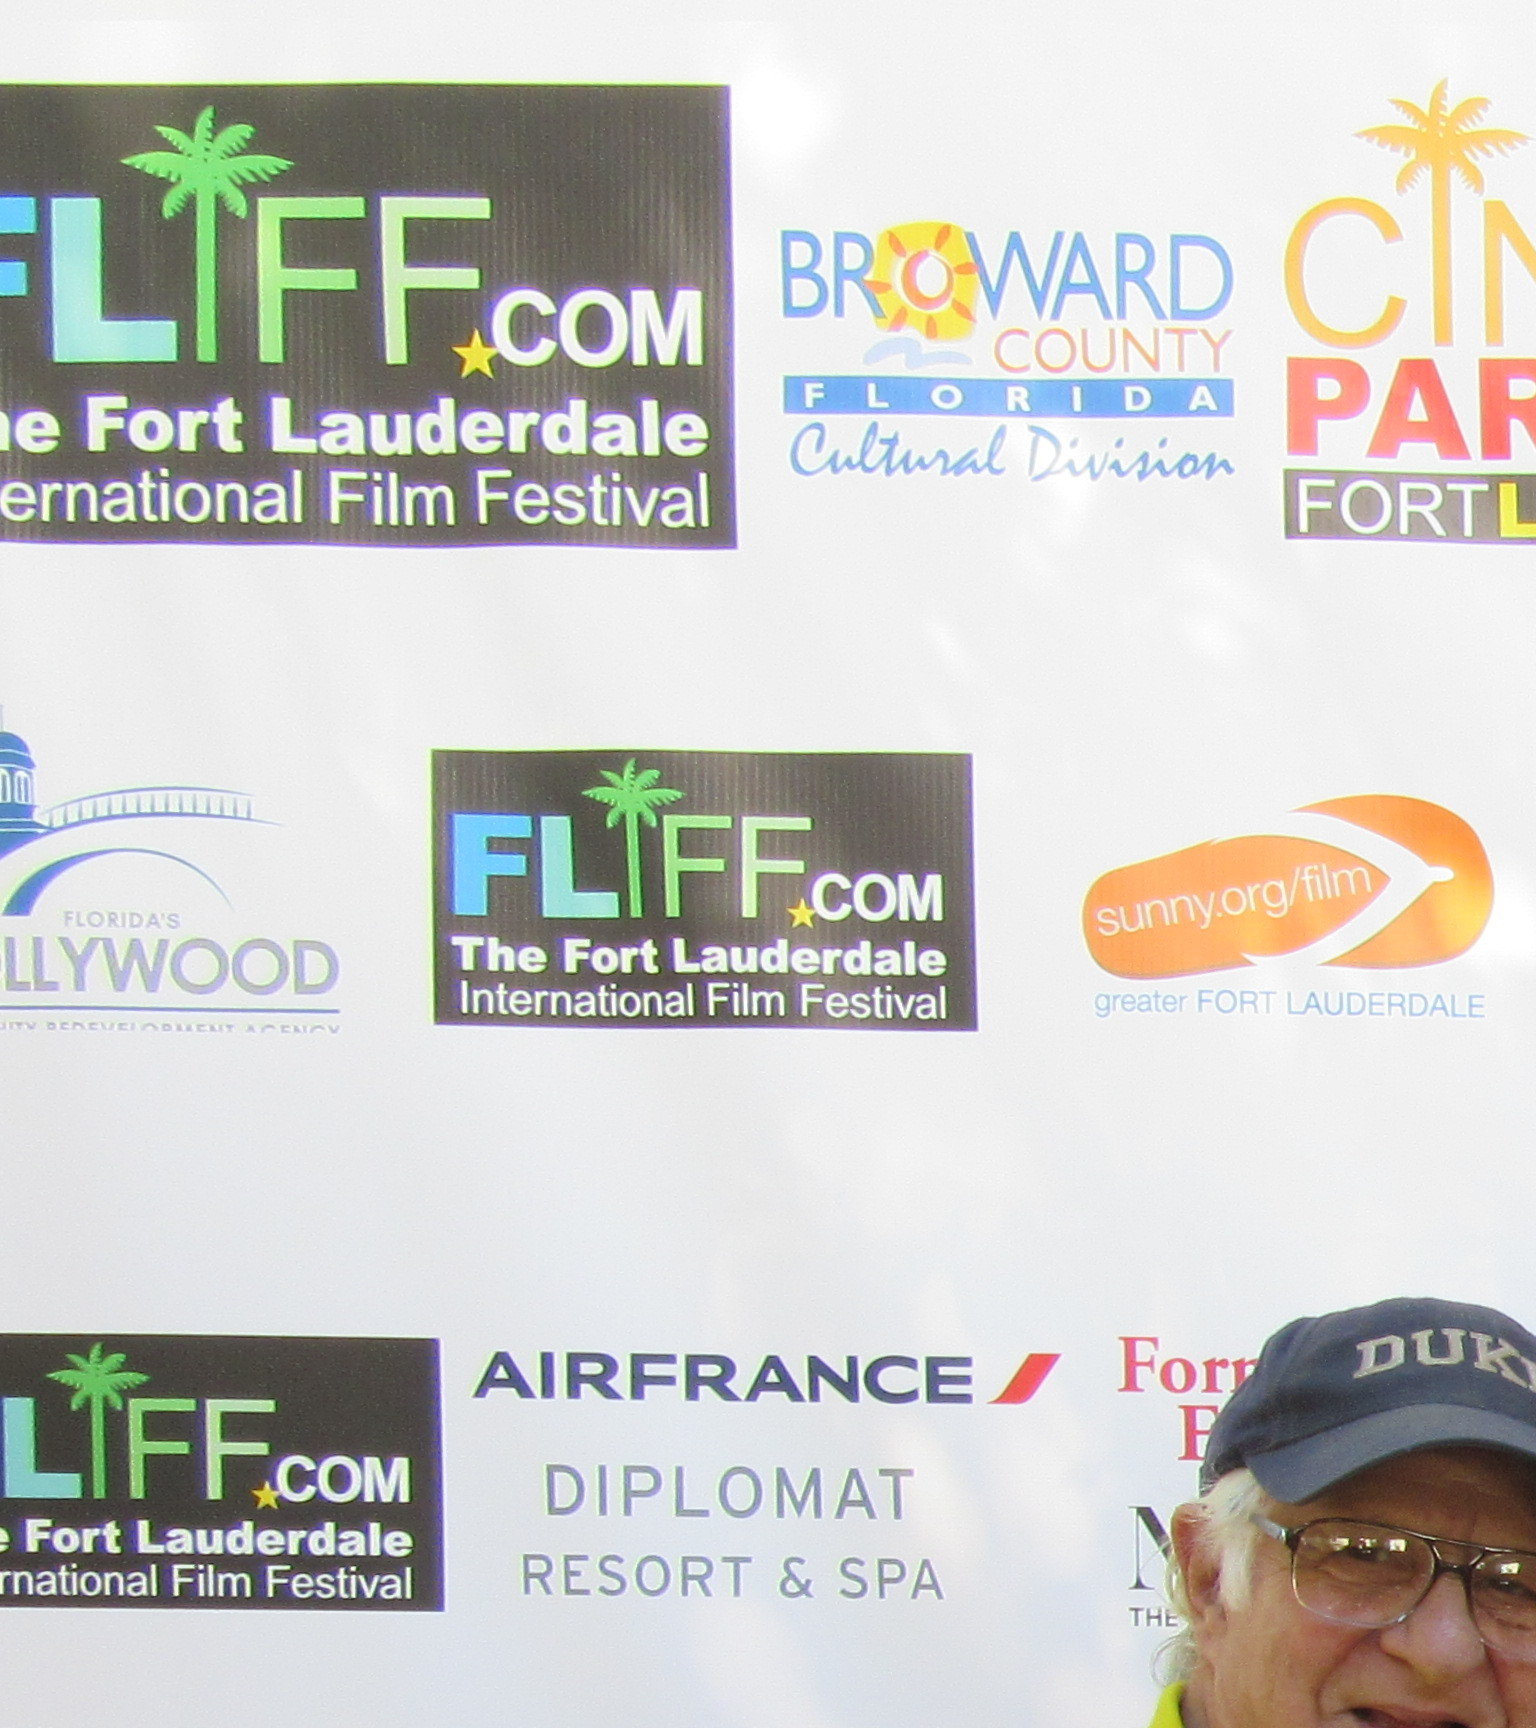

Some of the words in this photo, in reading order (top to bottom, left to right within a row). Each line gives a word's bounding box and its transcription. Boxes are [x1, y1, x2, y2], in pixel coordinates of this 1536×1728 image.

[780, 228, 1234, 320] BROWARD
[994, 328, 1234, 373] COUNTY
[804, 383, 1218, 413] FLORIDA
[86, 396, 242, 454] Fort
[271, 397, 710, 457] Lauderdale
[790, 421, 1008, 477] Cultural
[1027, 425, 1235, 481] Division
[328, 470, 456, 527] Film
[476, 469, 710, 529] Festival
[1296, 479, 1488, 538] FORT
[63, 910, 181, 929] FLORIDA'S
[1096, 862, 1373, 937] sunny.org/film
[452, 937, 547, 973] The
[564, 938, 659, 974] Fort
[673, 938, 948, 977] Lauderdale
[460, 981, 694, 1017] International
[707, 983, 785, 1018] Film
[801, 984, 948, 1020] Festival
[1094, 990, 1190, 1018] greater
[1197, 988, 1277, 1015] FORT
[1287, 990, 1486, 1018] LAUDERDALE
[472, 1351, 974, 1405] AIRFRANCE
[544, 1464, 914, 1519] DIPLOMAT
[25, 1518, 122, 1554] Fort
[137, 1520, 414, 1557] Lauderdale
[172, 1565, 252, 1598] Film
[266, 1565, 413, 1599] Festival
[522, 1553, 752, 1598] RESORT
[779, 1556, 814, 1598] &
[839, 1557, 944, 1600] SPA
